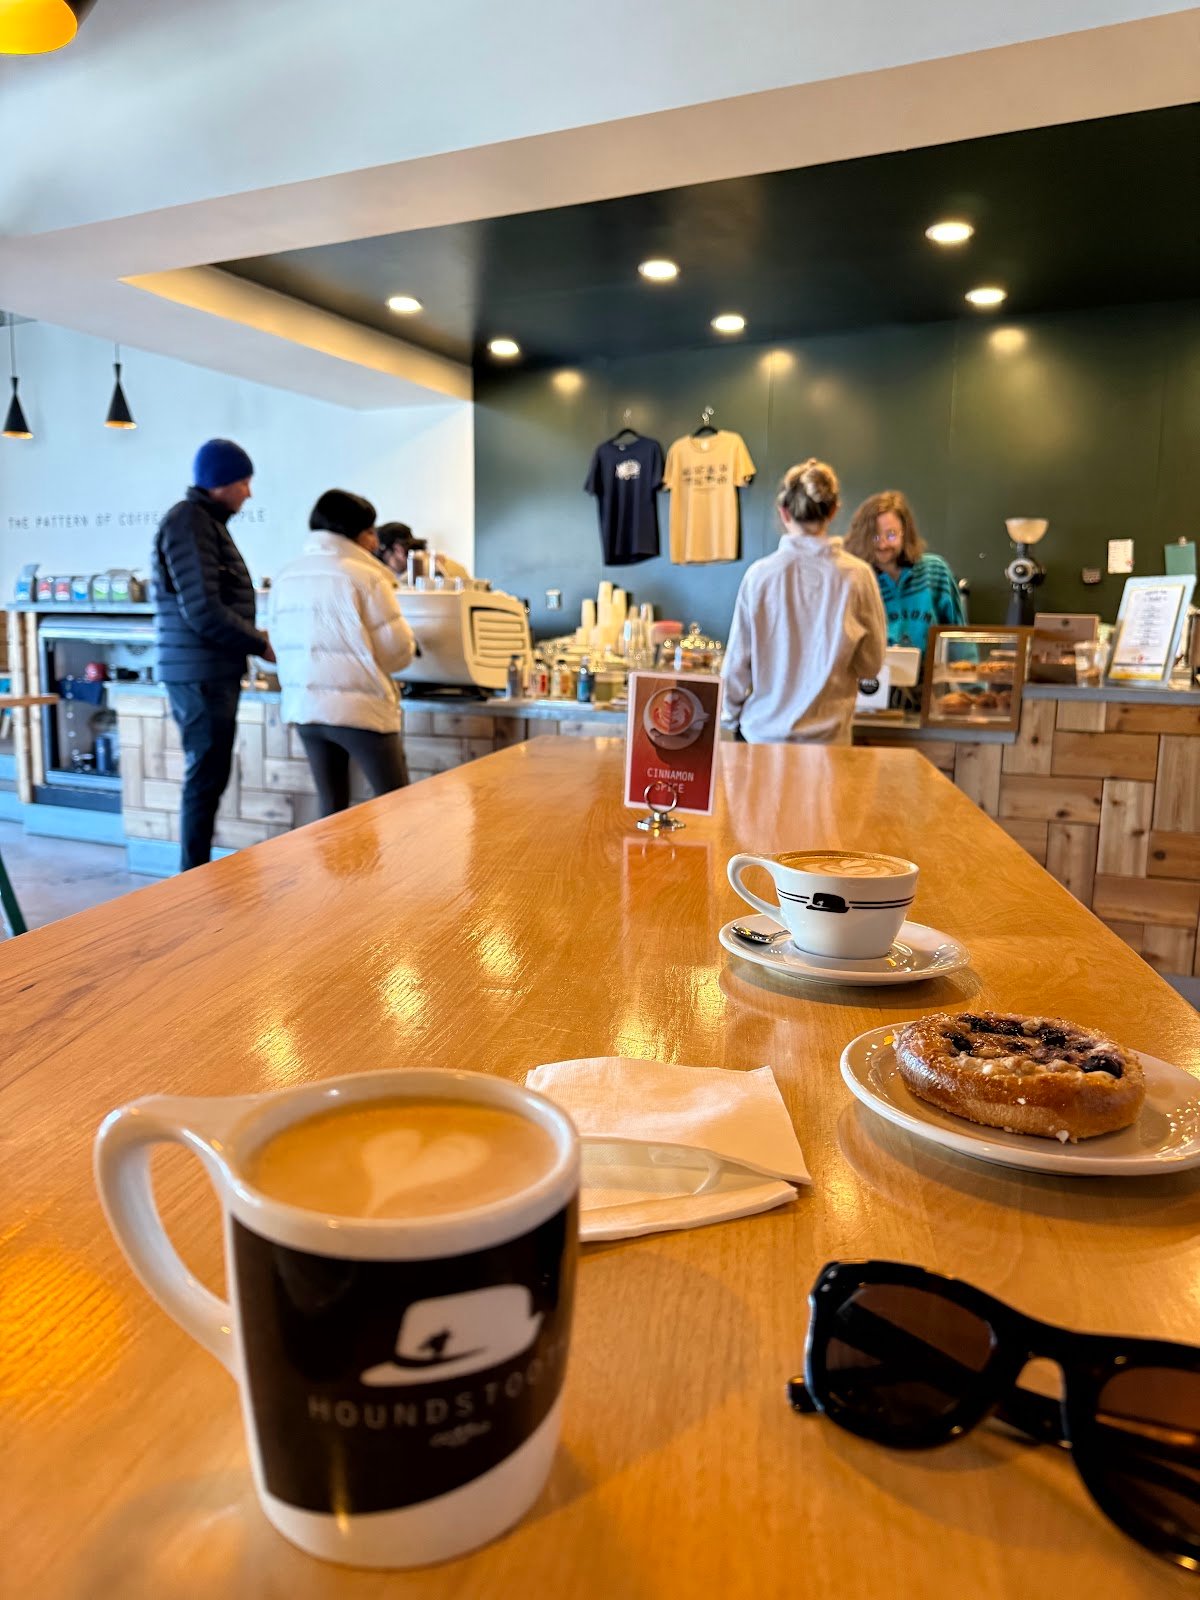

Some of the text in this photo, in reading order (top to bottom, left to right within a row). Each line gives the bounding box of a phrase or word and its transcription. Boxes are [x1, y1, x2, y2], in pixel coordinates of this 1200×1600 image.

[8, 516, 30, 530] THE
[35, 513, 88, 528] PATTERN
[95, 512, 112, 527] OF
[119, 510, 160, 526] COFFE
[646, 767, 694, 782] CINNAMON
[307, 1345, 556, 1429] HOUNDSTOO
